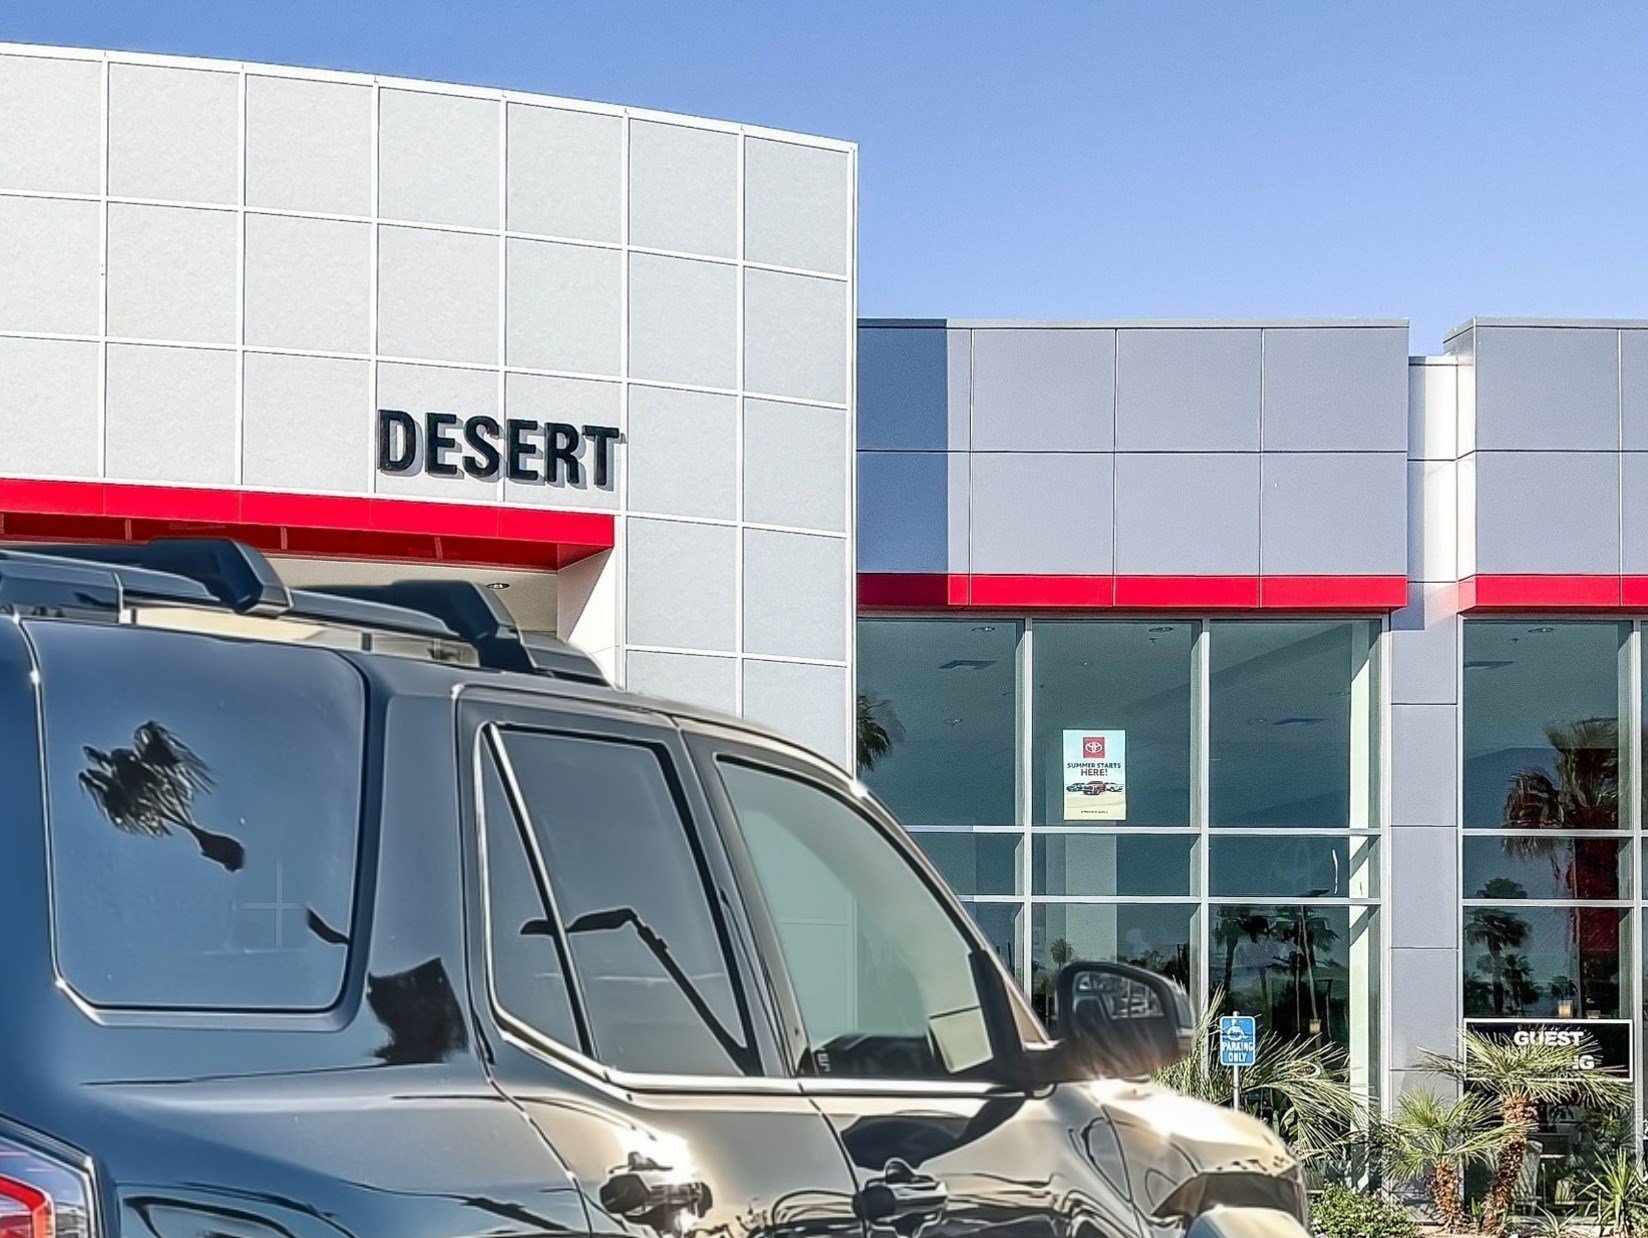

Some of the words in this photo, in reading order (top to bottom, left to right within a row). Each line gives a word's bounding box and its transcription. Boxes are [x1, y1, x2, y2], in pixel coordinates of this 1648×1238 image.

[377, 409, 621, 487] DESERT
[1080, 768, 1108, 776] HERE!
[1513, 1031, 1584, 1047] GUEST
[1222, 1041, 1253, 1052] PARKING
[1228, 1052, 1247, 1062] ONLY
